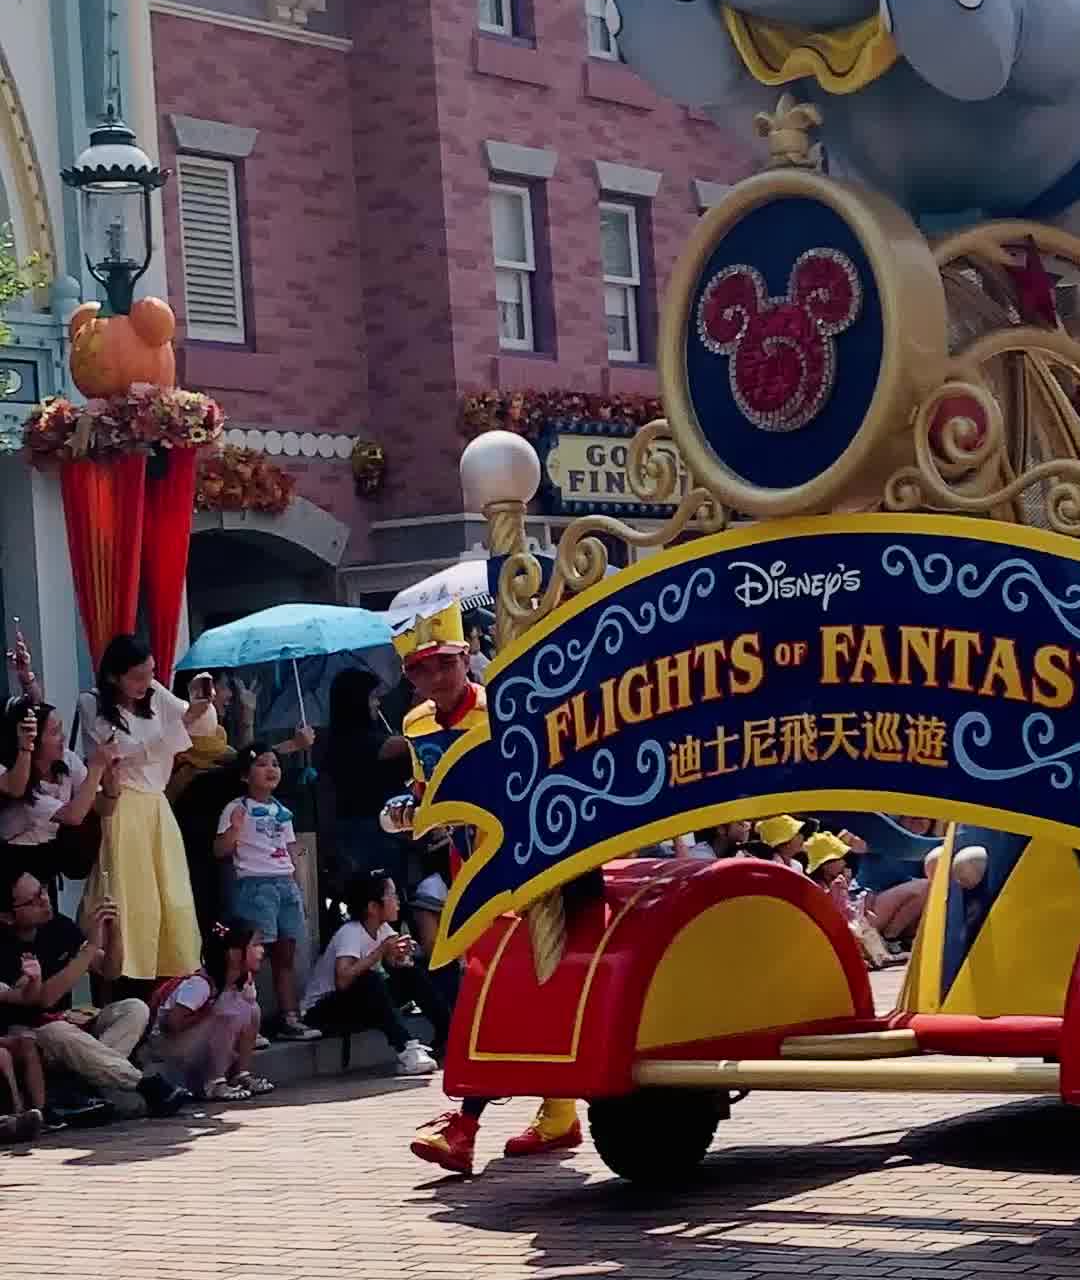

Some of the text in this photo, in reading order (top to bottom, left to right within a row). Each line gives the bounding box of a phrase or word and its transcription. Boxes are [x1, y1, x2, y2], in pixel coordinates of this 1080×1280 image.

[543, 631, 766, 769] FLIGHTS
[773, 640, 809, 667] OF
[667, 711, 950, 788] 迪士尼飛天巡遊
